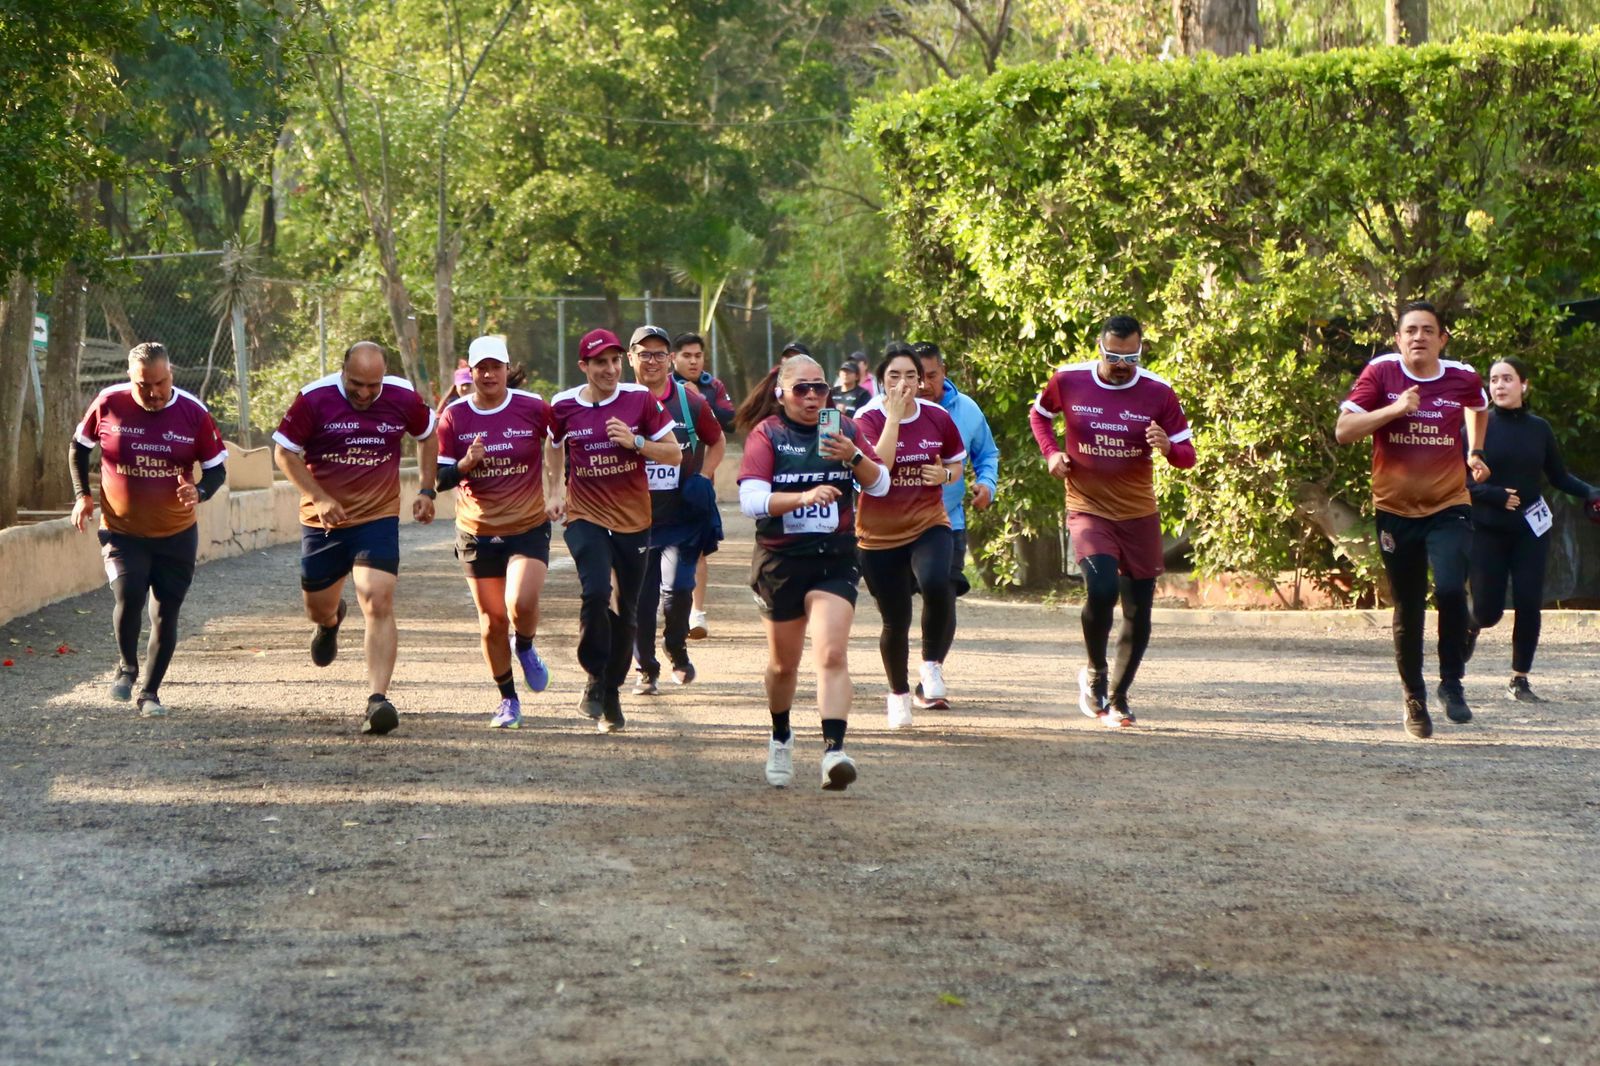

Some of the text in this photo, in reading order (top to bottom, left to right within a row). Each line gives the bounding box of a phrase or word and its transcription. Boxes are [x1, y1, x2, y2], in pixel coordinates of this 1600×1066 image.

[1071, 404, 1104, 414] CONADE
[111, 425, 145, 435] CONADE
[323, 422, 360, 430] CONADE
[1090, 421, 1129, 432] CARRERA
[1409, 422, 1439, 434] Plan
[345, 437, 386, 445] CARRERA
[1094, 433, 1125, 447] Plan
[1389, 432, 1455, 446] Michoacán
[131, 442, 172, 453] CARRERA
[483, 442, 513, 453] ARRERA
[1078, 442, 1143, 458] Michoacán
[135, 455, 167, 467] Plan
[482, 456, 511, 467] Plan
[589, 454, 618, 467] Plan
[895, 453, 930, 463] CARRERA
[116, 463, 185, 478] Michoacán
[575, 460, 638, 477] Michoacán
[647, 467, 676, 480] 704
